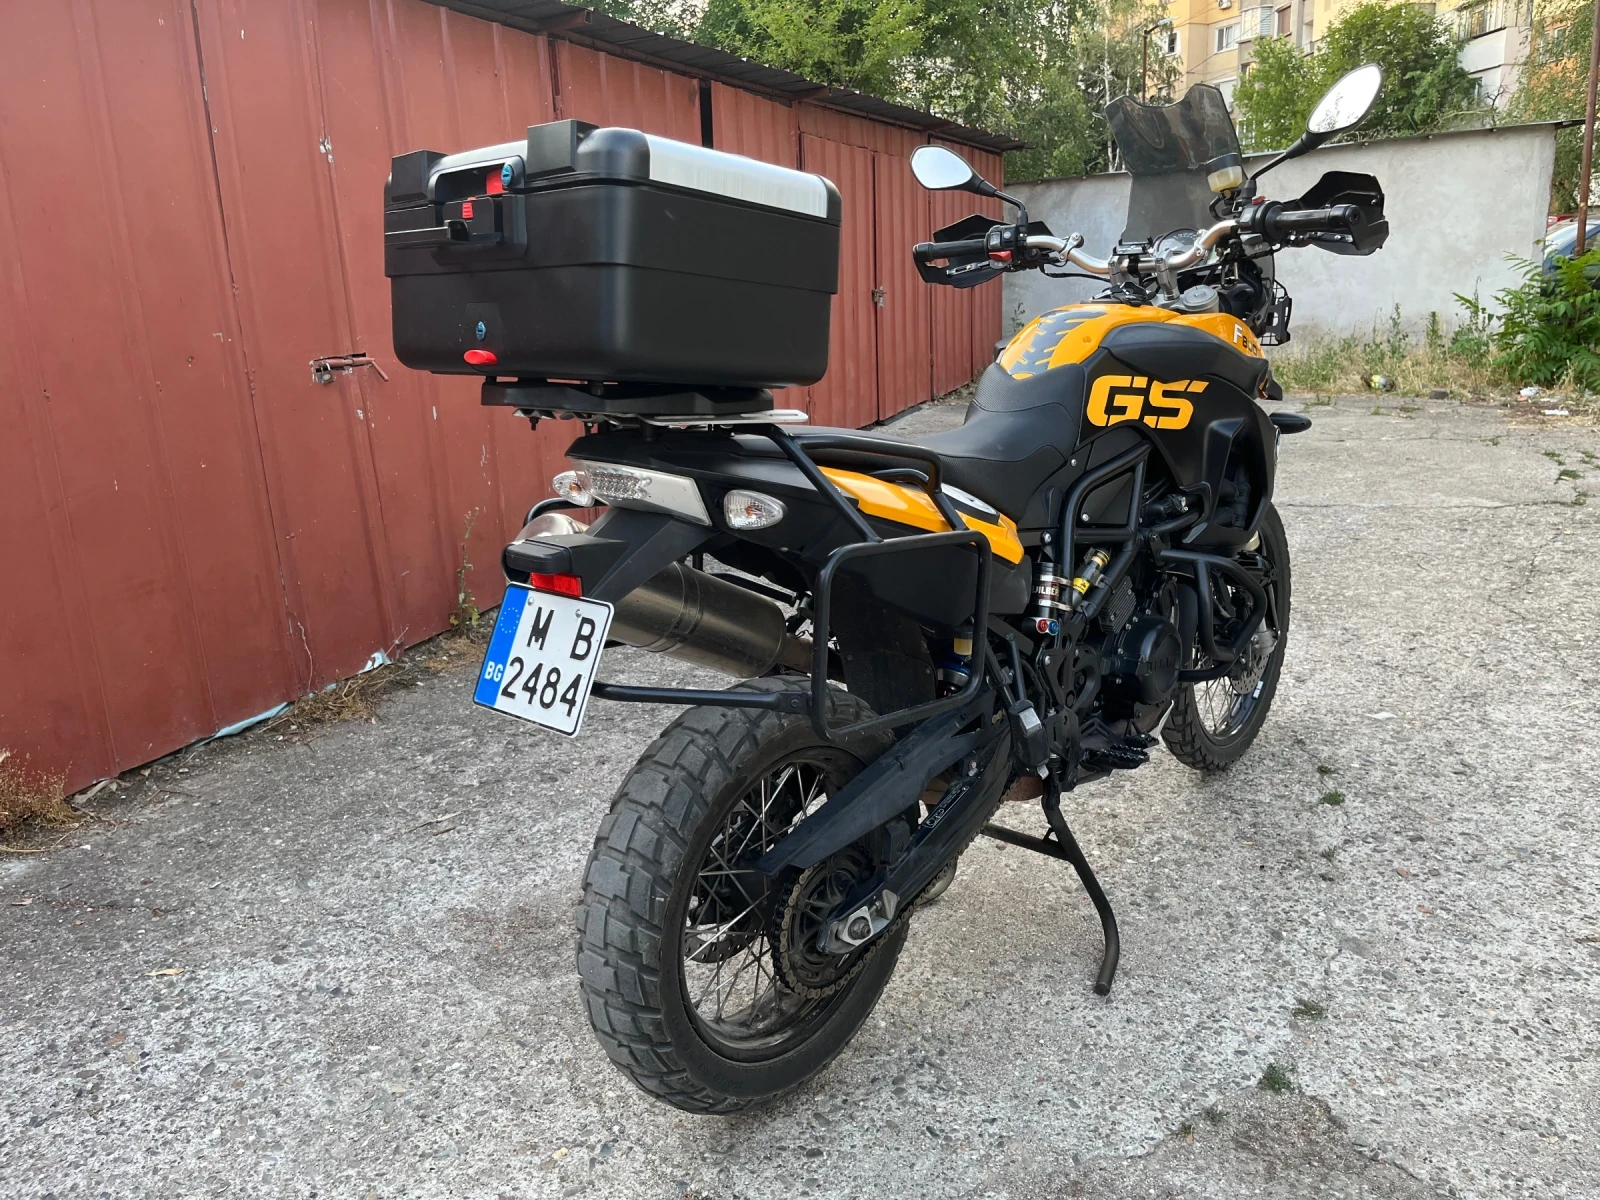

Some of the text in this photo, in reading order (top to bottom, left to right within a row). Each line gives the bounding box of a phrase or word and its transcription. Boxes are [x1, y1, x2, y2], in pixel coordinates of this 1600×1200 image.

[1086, 375, 1209, 430] GS
[526, 606, 596, 661] M B
[484, 661, 504, 682] BG
[501, 656, 583, 717] 2484
